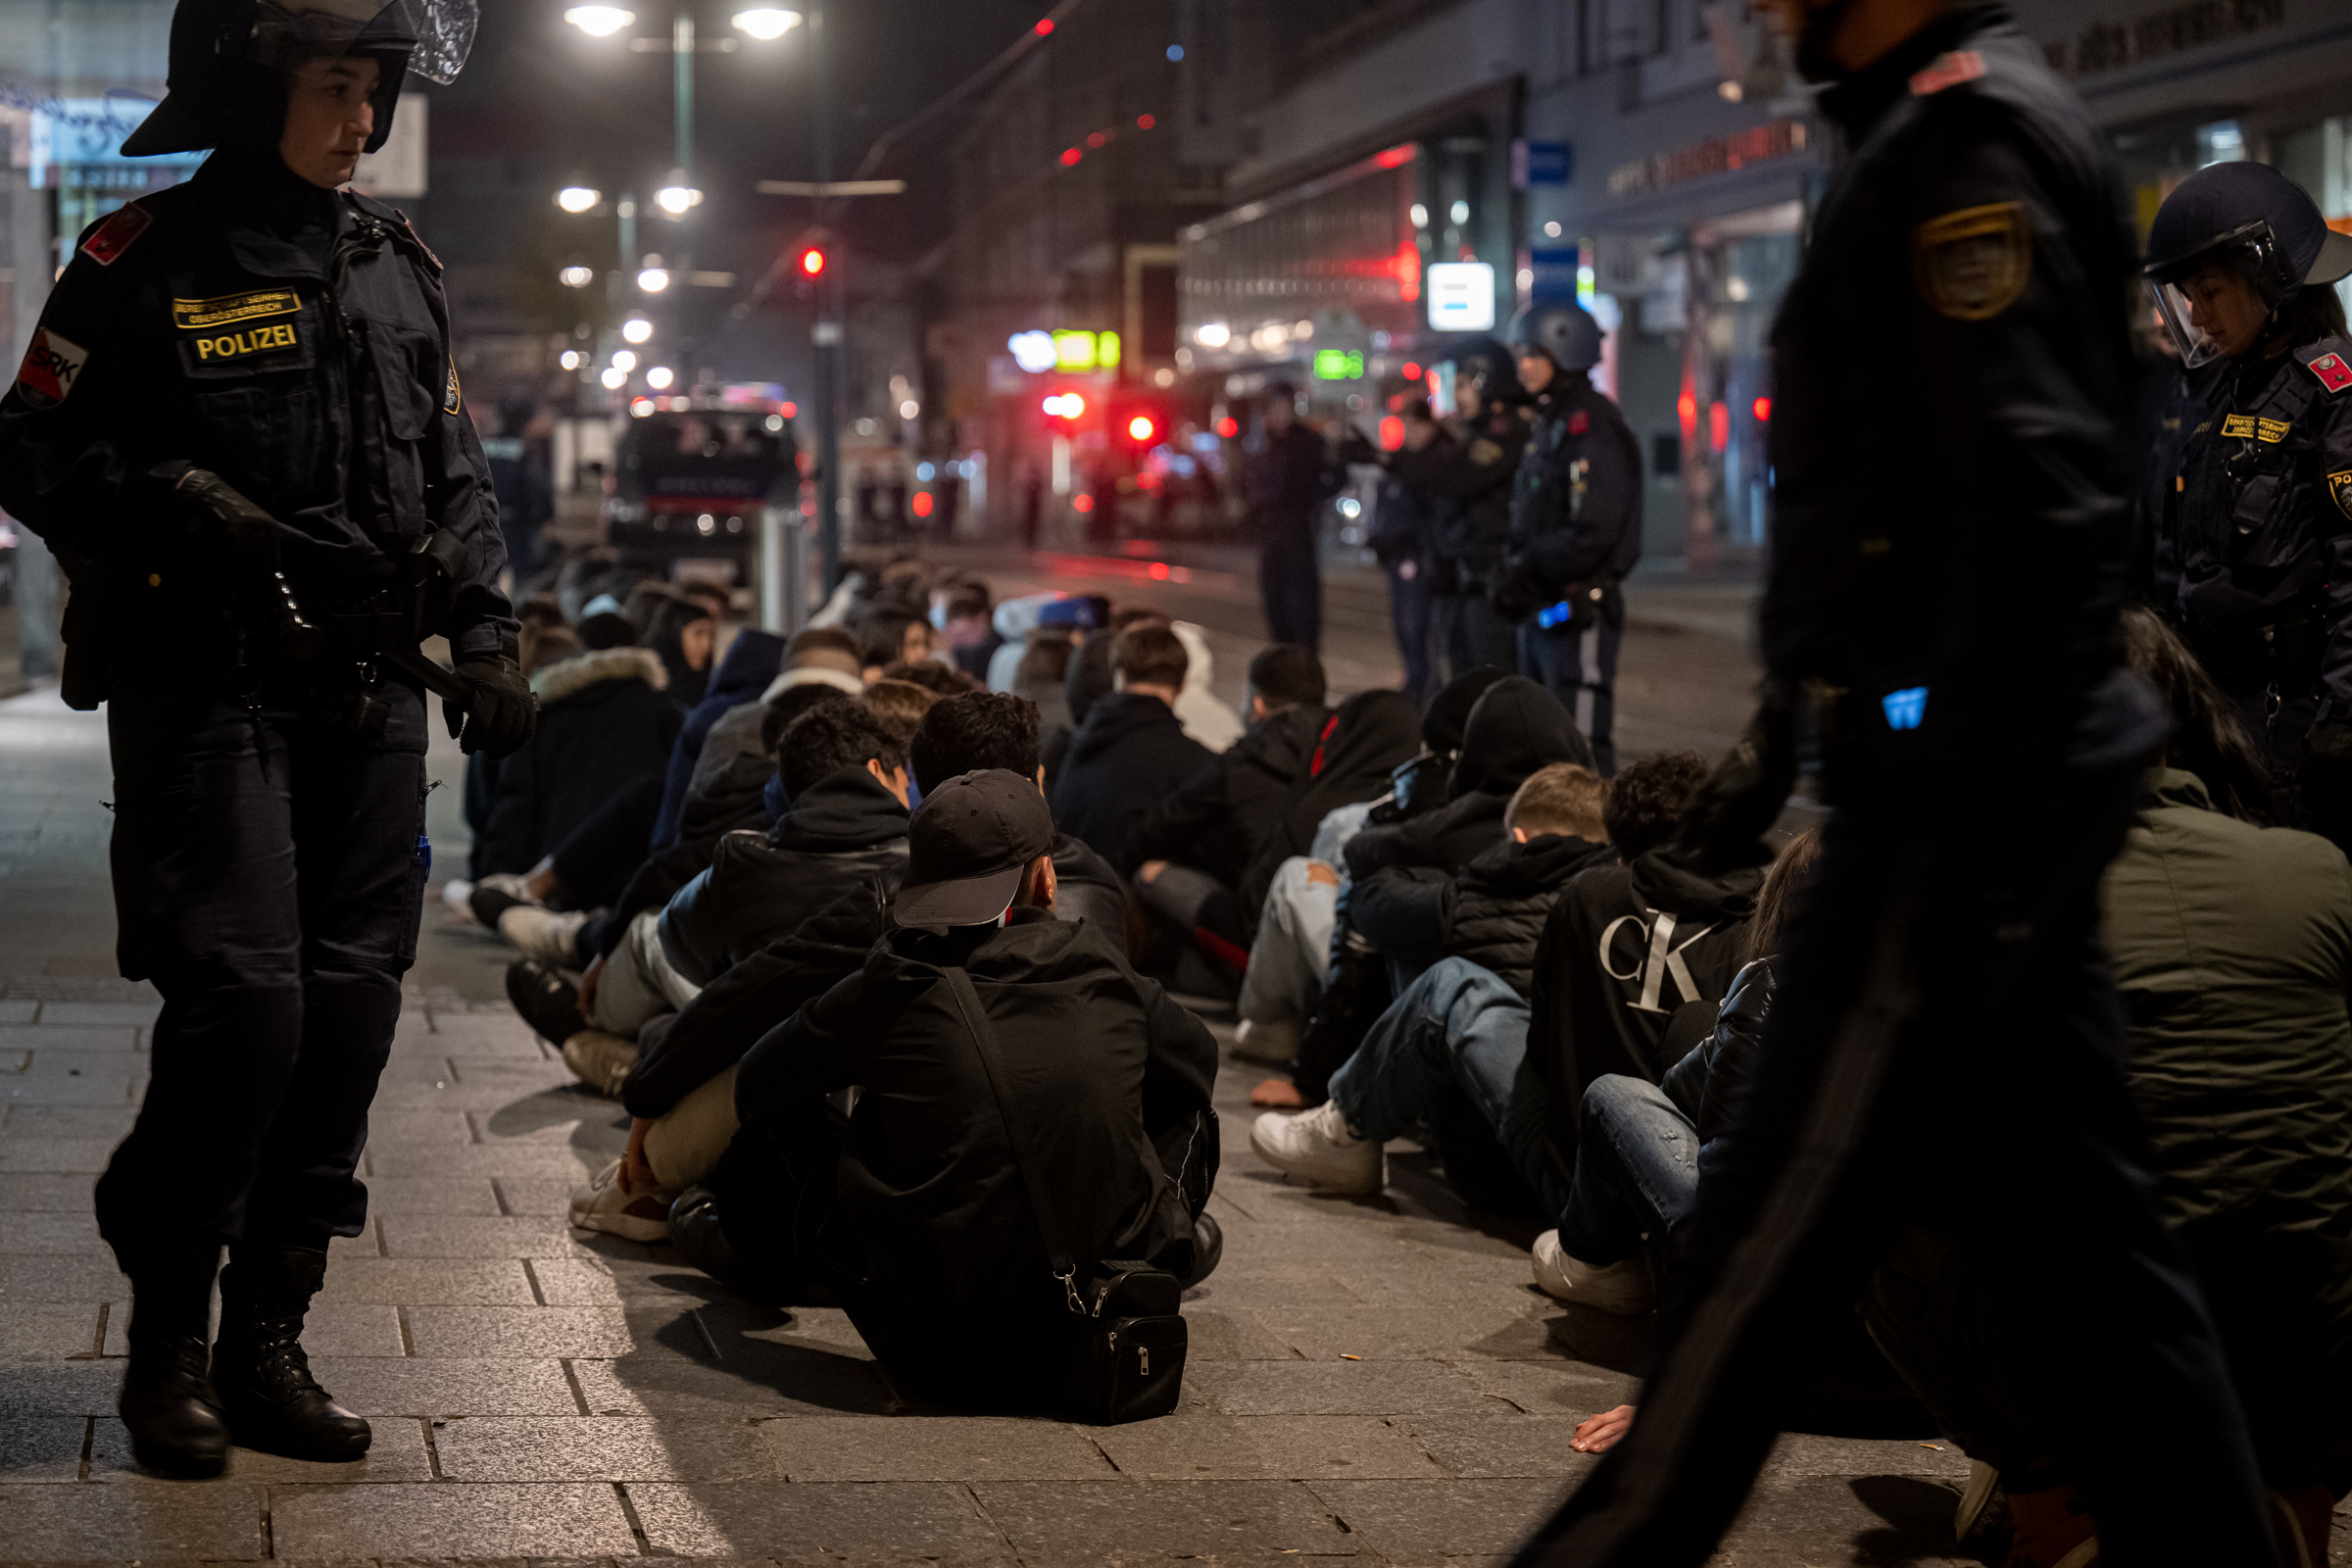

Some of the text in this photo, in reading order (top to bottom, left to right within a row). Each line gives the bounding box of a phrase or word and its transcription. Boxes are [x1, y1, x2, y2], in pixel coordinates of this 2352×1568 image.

[196, 323, 297, 360] POLIZEI
[29, 346, 79, 383] SRK
[1598, 907, 1723, 1015] CK
